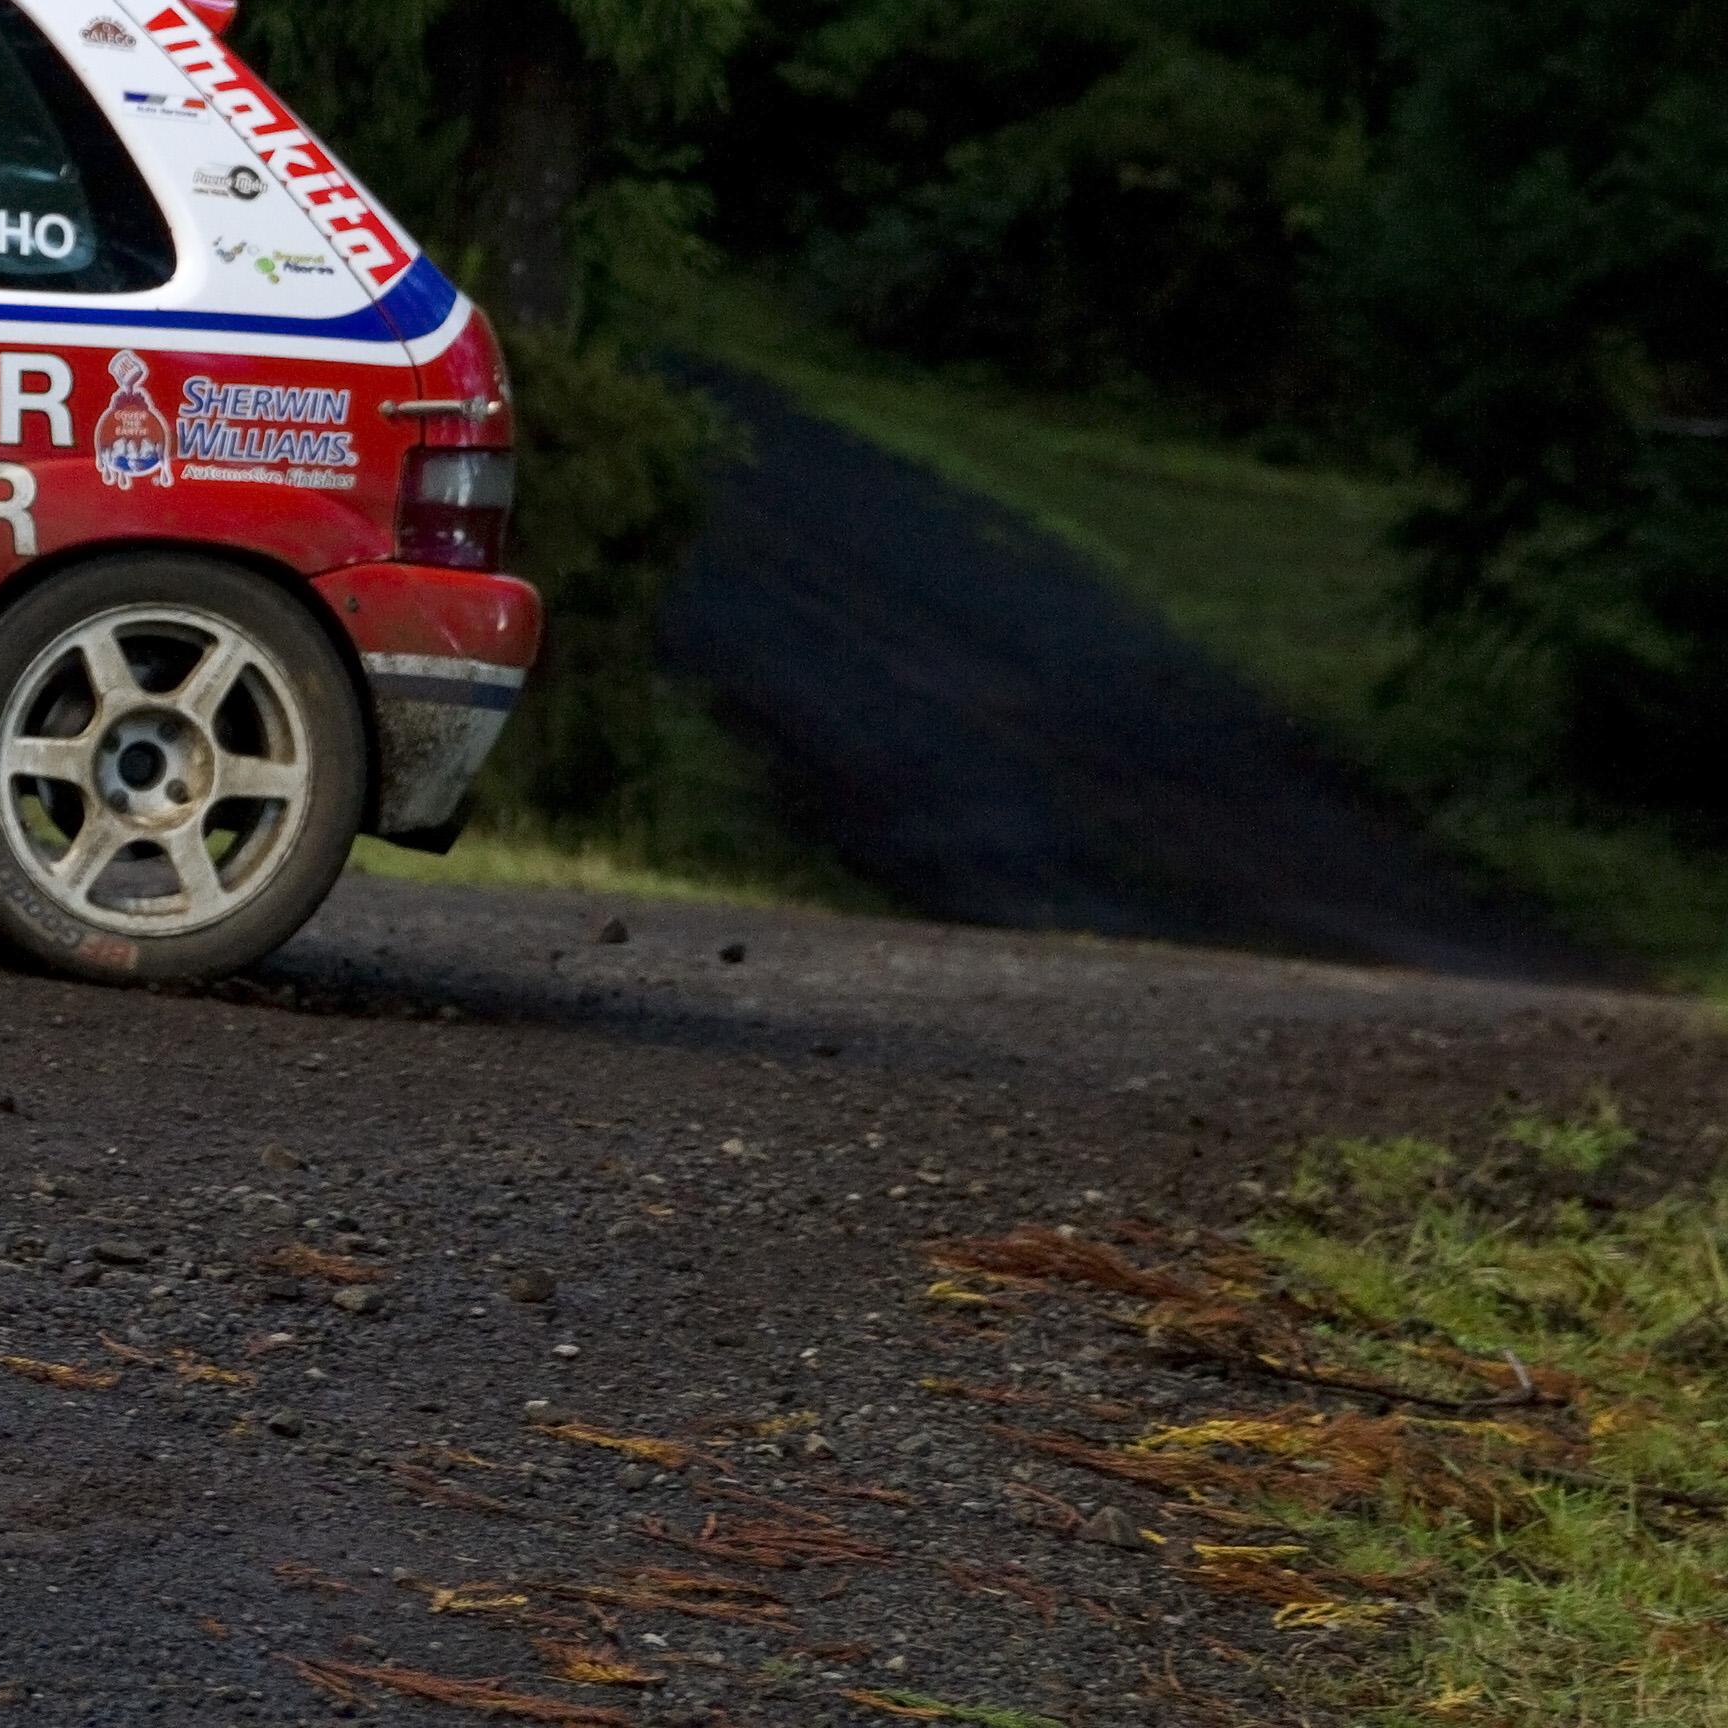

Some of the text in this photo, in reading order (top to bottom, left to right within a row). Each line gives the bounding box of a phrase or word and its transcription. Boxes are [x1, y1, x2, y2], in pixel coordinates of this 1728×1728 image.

[148, 20, 396, 282] makita
[180, 375, 351, 424] SHERWIN
[181, 462, 357, 490] Automotive Finishes
